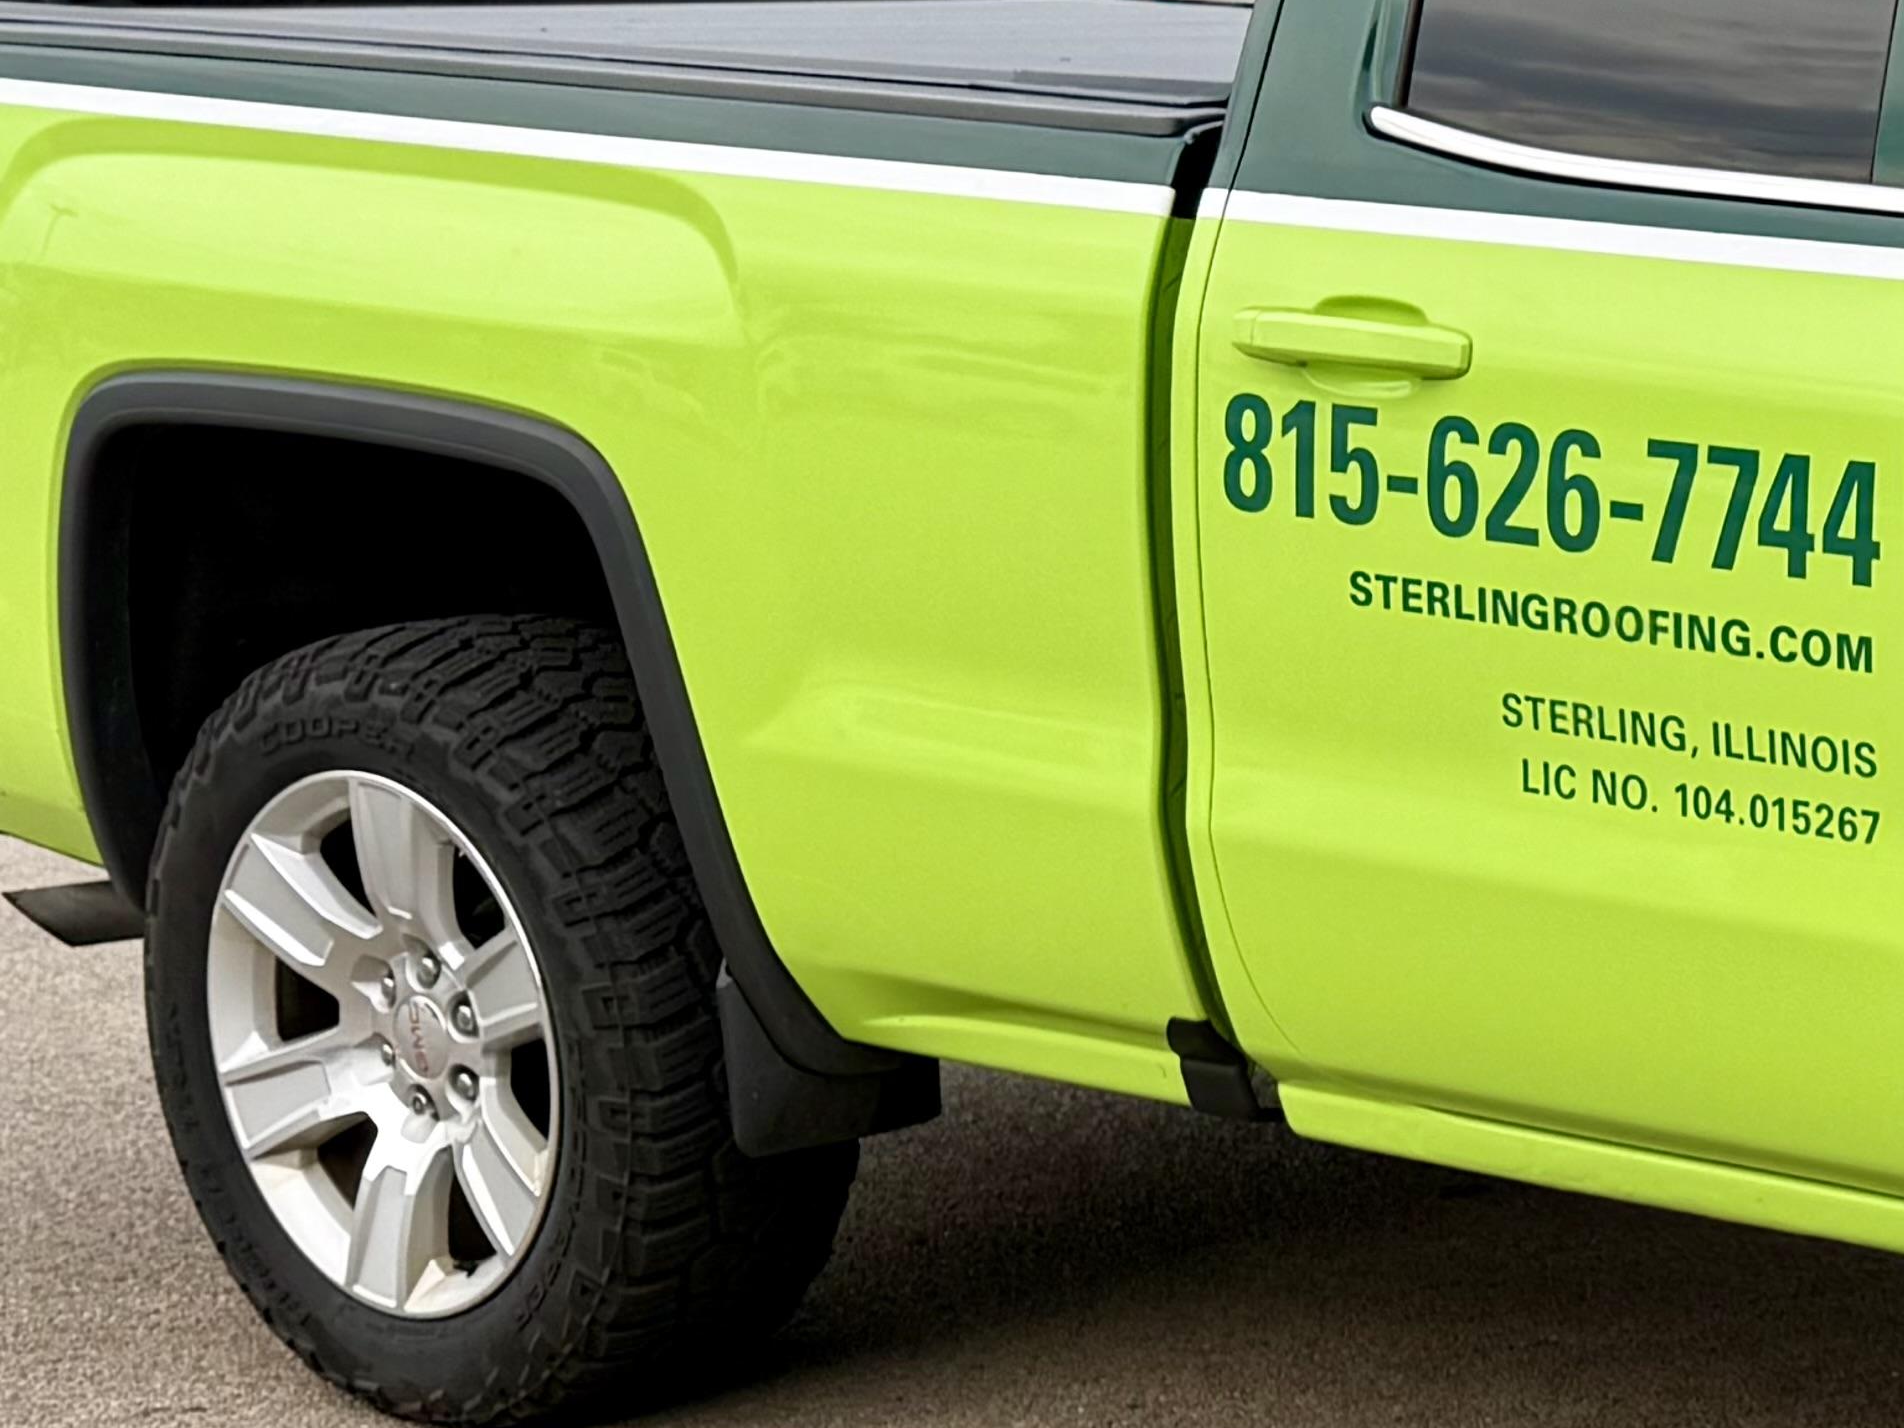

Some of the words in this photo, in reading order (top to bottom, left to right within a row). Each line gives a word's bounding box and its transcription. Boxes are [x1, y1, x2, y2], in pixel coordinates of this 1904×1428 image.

[1222, 392, 1882, 588] 815-626-7744
[1348, 570, 1874, 674] STERLINGROOFING.COM
[1501, 692, 1700, 761] STERLING,
[1711, 720, 1878, 780] ILLINOIS
[1521, 758, 1577, 801] LIC
[1591, 767, 1660, 811] NO.
[1674, 782, 1881, 846] 104.015267
